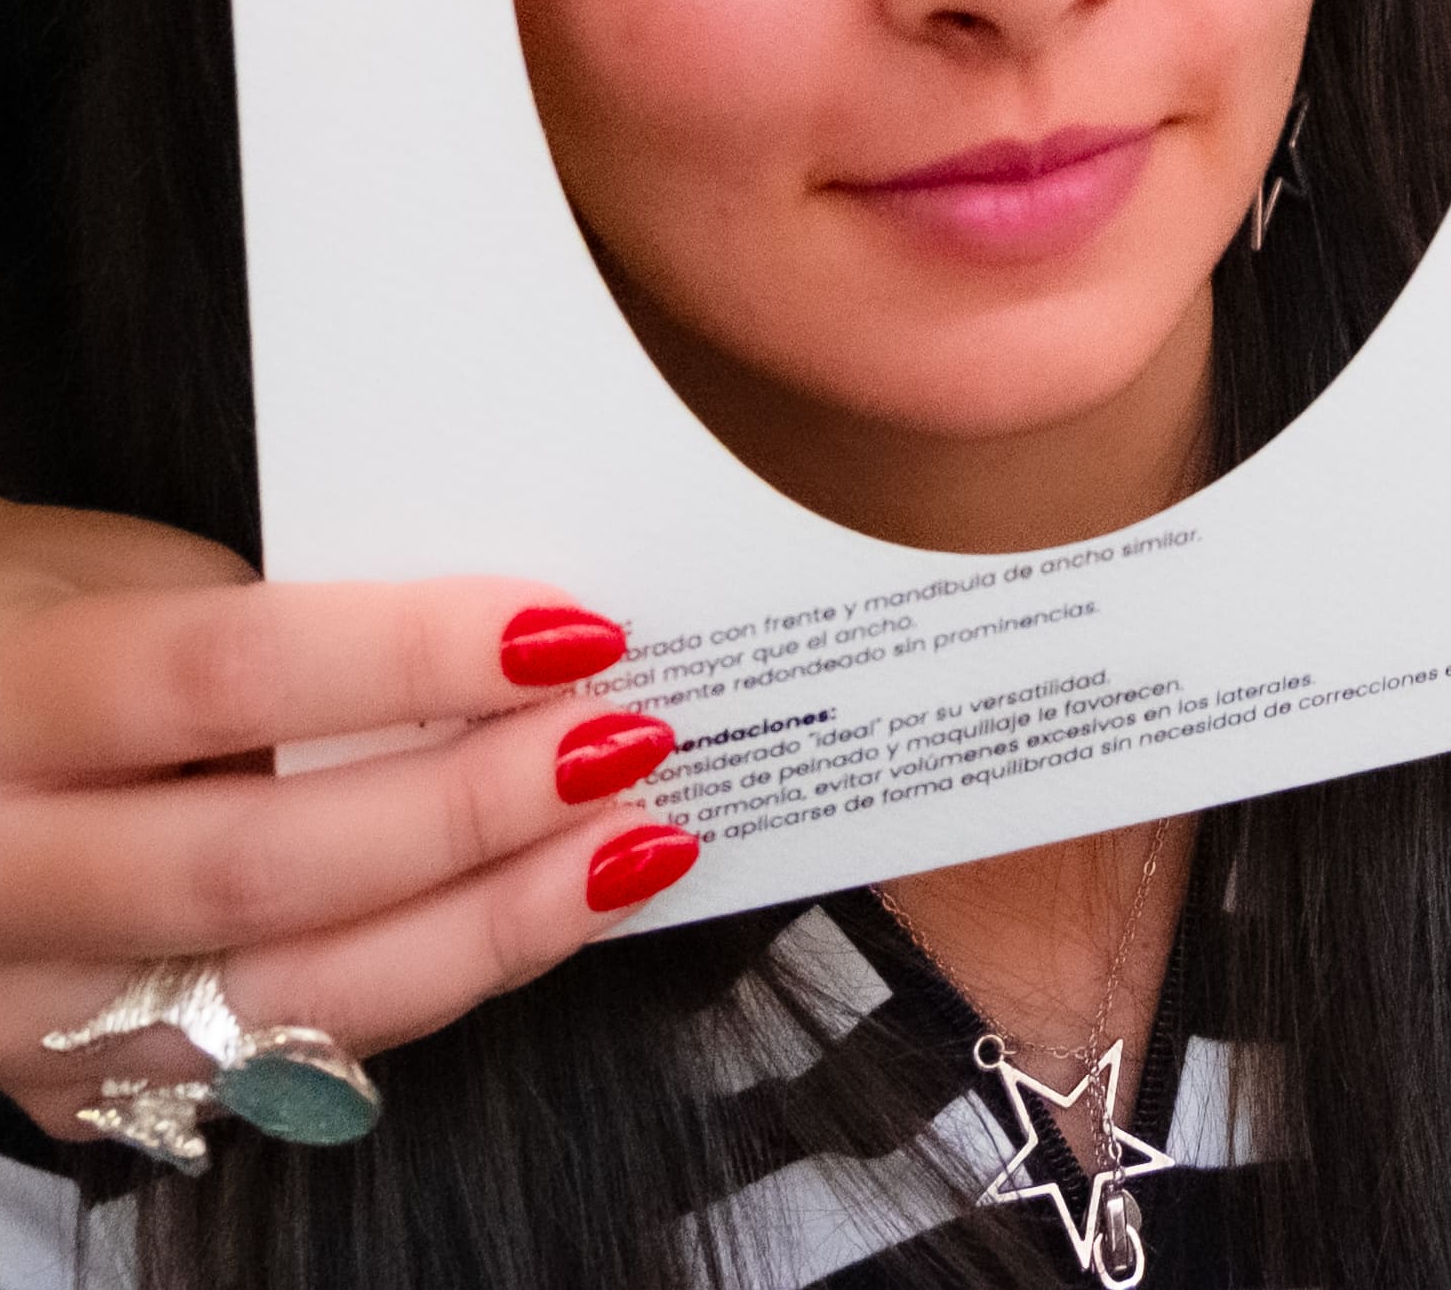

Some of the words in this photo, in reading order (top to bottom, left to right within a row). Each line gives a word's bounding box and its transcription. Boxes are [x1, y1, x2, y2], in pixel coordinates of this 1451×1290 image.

[709, 623, 756, 645] con
[763, 606, 836, 632] frente
[843, 602, 857, 620] y
[1003, 565, 1033, 582] de
[1039, 547, 1114, 575] ancho
[1121, 529, 1200, 557] similar.
[662, 651, 744, 681] mayor
[751, 640, 799, 665] que
[805, 630, 827, 650] el
[733, 647, 885, 690] redondeado
[893, 637, 926, 657] sin
[933, 601, 1100, 652] prominencias.
[653, 779, 732, 807] estilos
[739, 771, 771, 788] de
[778, 747, 879, 784] peinado
[886, 742, 899, 760] y
[906, 712, 1031, 751] maquillaje
[1038, 707, 1057, 721] le
[1064, 680, 1183, 717] favorecen.
[723, 803, 836, 840] aplicarse
[843, 794, 874, 812] de
[881, 776, 953, 803] forma
[960, 745, 1093, 786] equilibrada
[1100, 736, 1131, 755] sin
[1138, 705, 1256, 746] necesidad
[1263, 701, 1291, 718] de
[1298, 668, 1438, 710] correcciones
[814, 769, 882, 795] evitar
[1026, 713, 1136, 748] excesivos
[1143, 705, 1170, 722] en
[1177, 696, 1208, 714] los
[1216, 674, 1315, 705] laterales.
[888, 711, 928, 734] por
[935, 704, 962, 721] su
